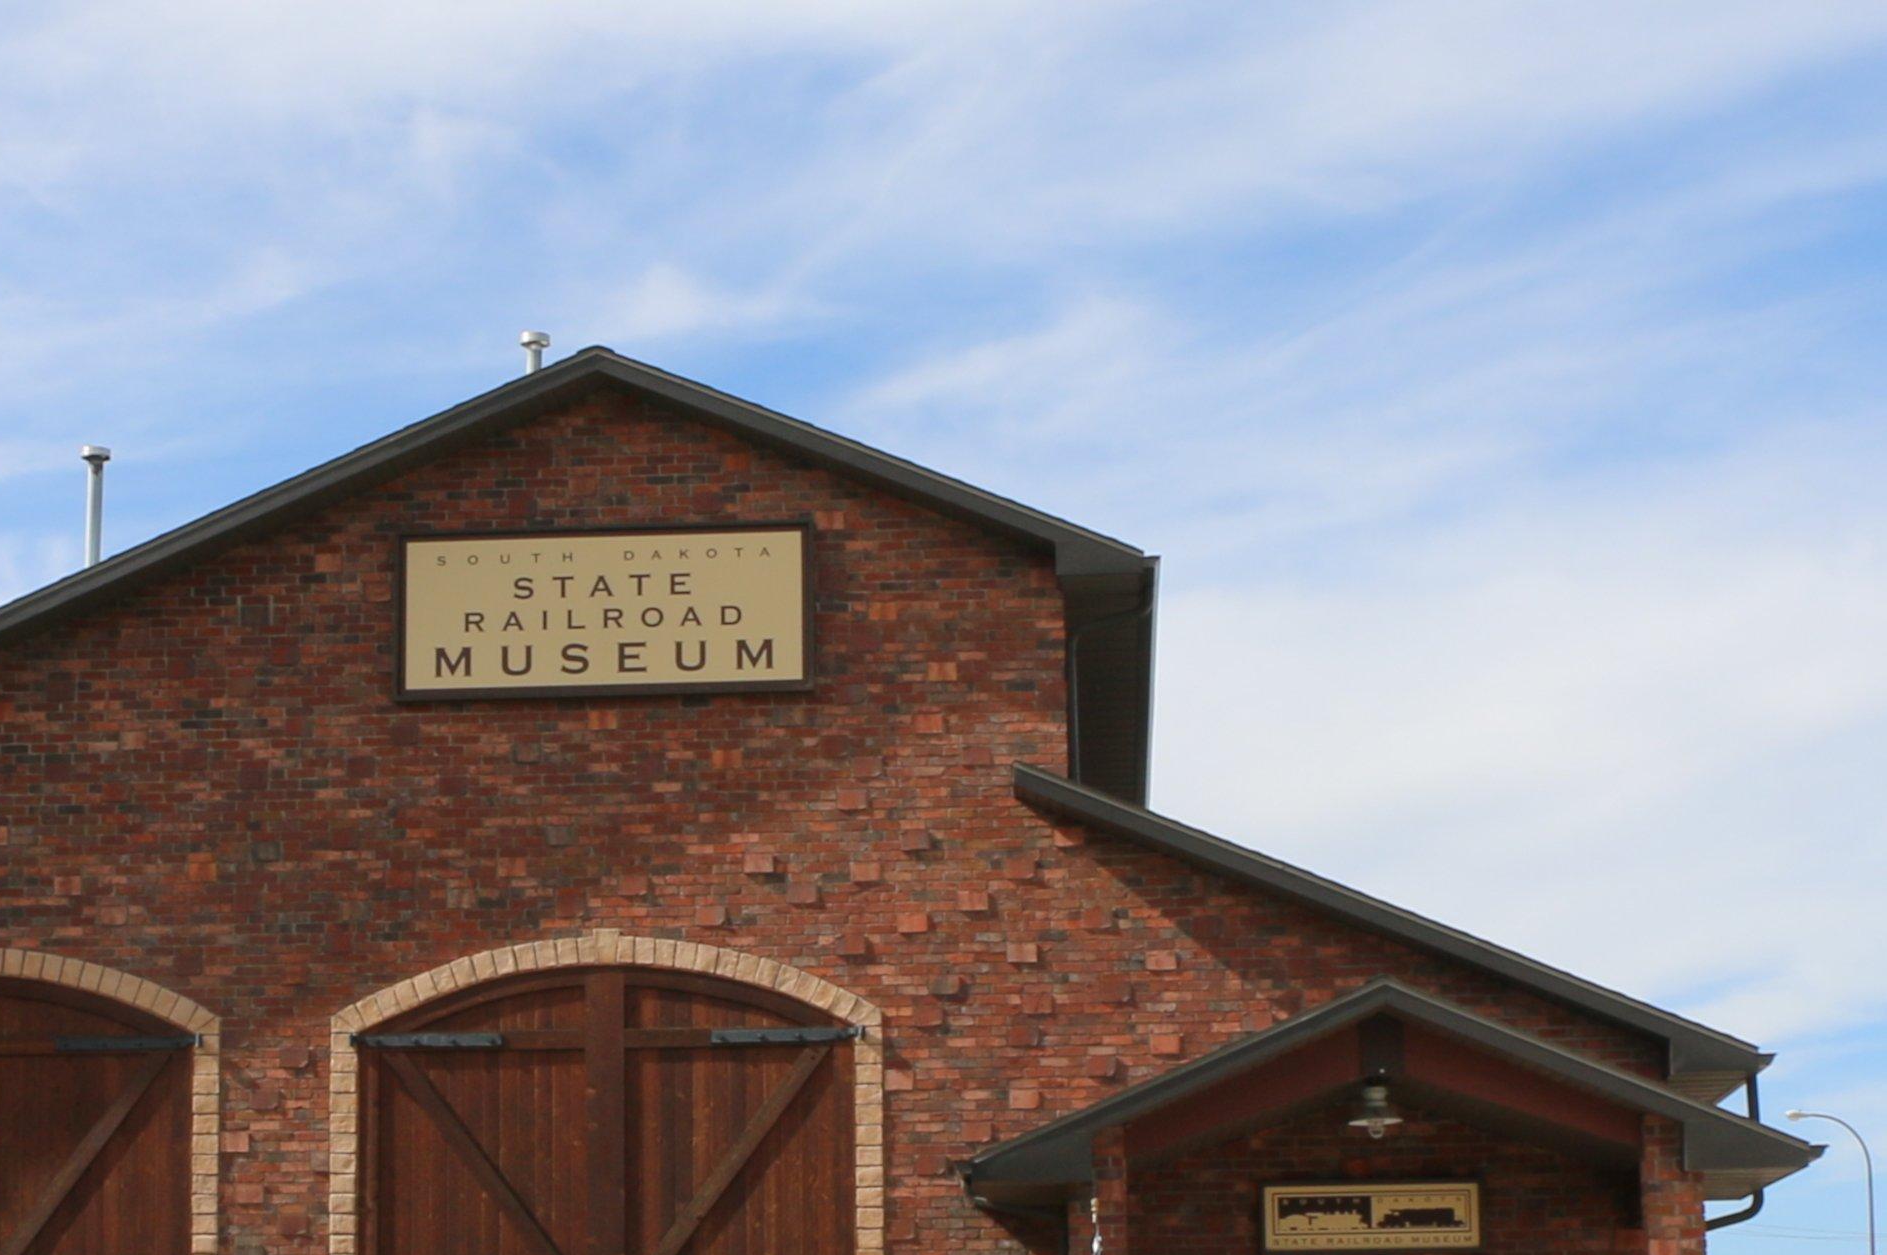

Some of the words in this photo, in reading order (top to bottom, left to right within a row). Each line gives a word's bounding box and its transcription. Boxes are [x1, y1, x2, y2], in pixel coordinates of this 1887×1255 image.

[436, 552, 574, 567] SOUTH
[623, 546, 771, 561] DAKOTA
[513, 572, 692, 600] STATE
[463, 605, 743, 633] RAILROAD
[434, 638, 774, 678] MUSEUM
[1273, 1237, 1318, 1247] STATE
[1326, 1235, 1403, 1245] RAILROAD
[1411, 1234, 1473, 1243] MUSEUM
